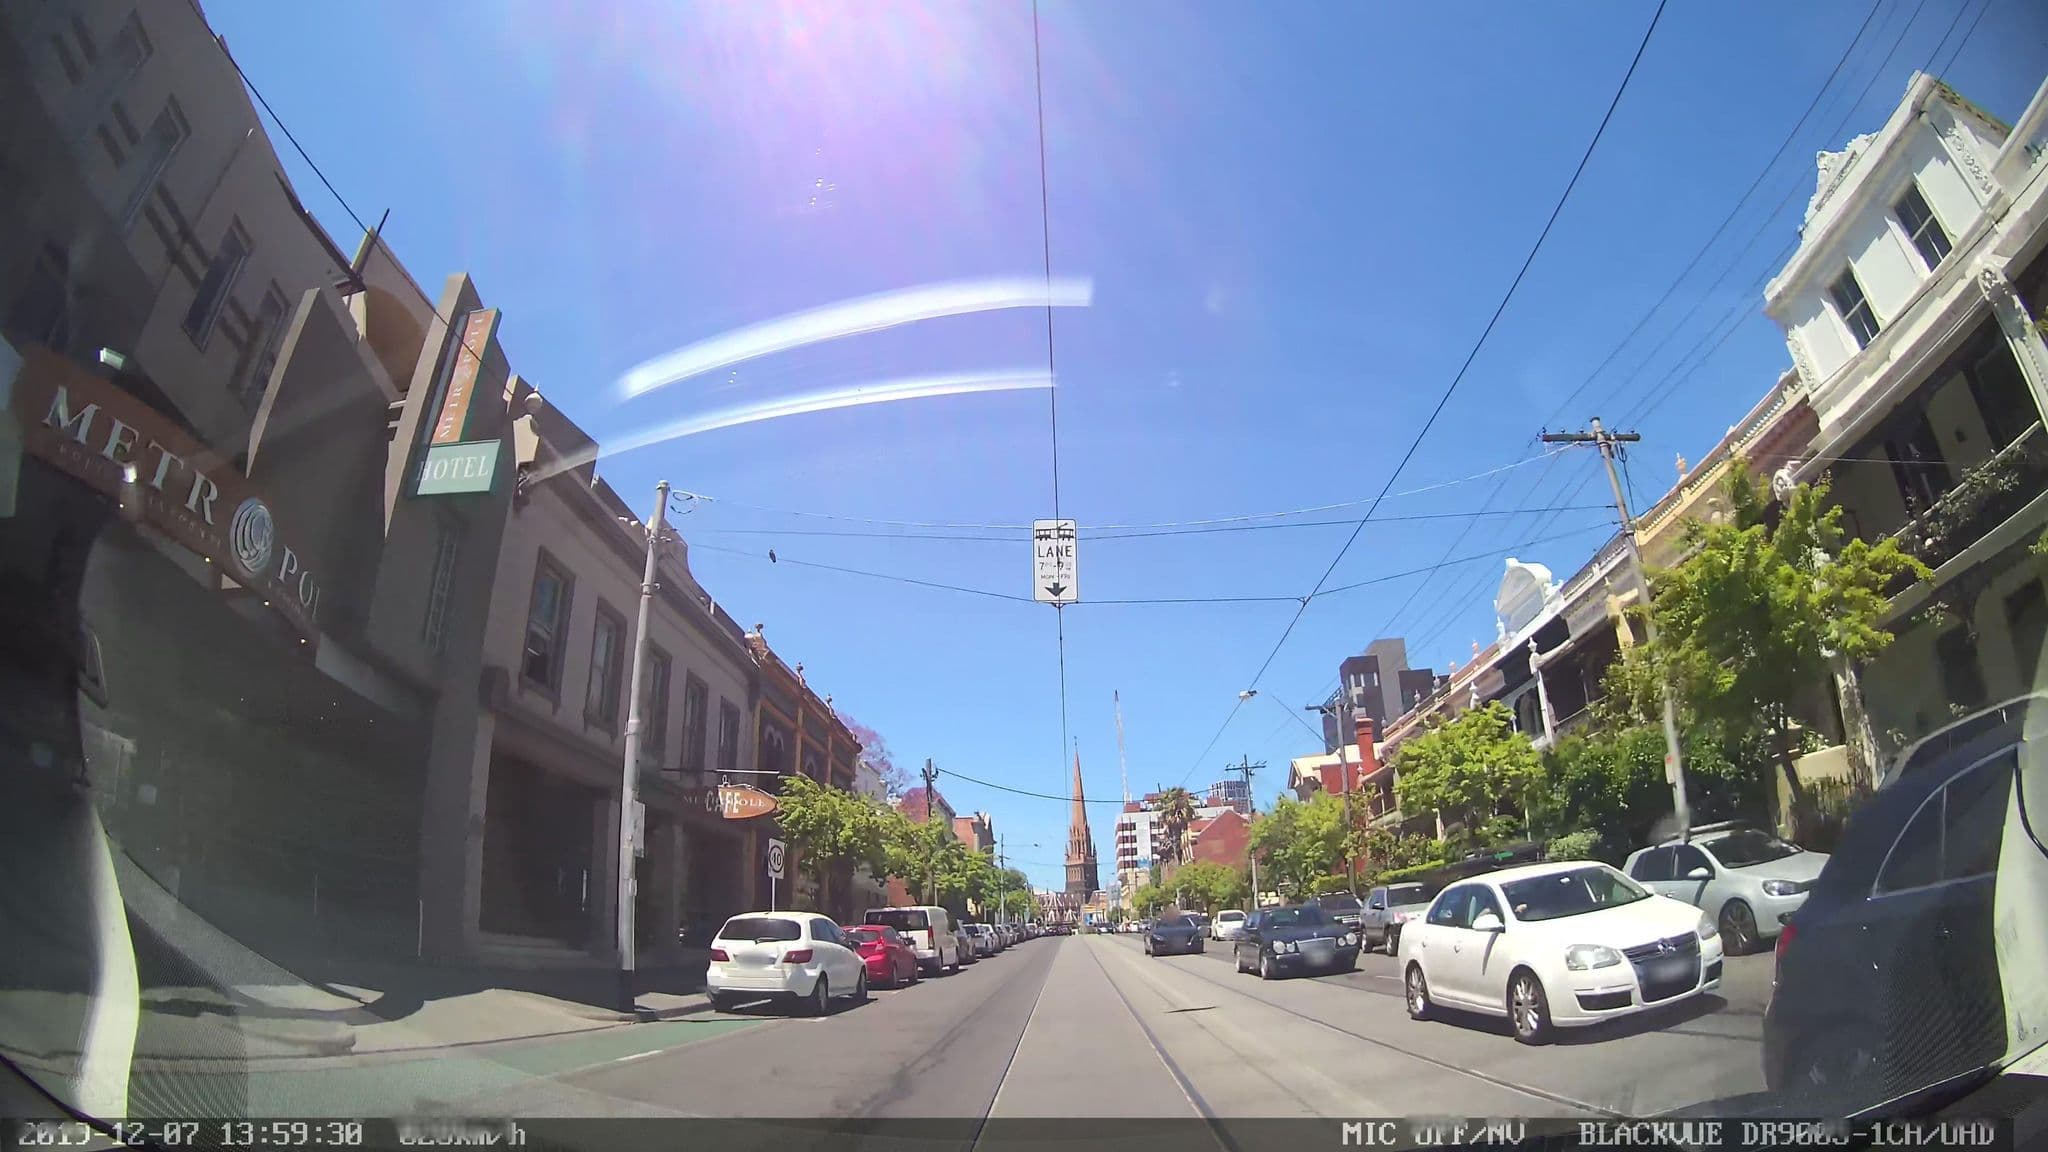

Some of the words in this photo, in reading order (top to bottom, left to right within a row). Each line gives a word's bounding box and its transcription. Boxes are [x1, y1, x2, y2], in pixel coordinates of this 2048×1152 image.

[416, 455, 489, 482] HOTEL
[1037, 545, 1073, 558] LANE
[705, 790, 740, 814] CAFE
[772, 852, 782, 866] 40
